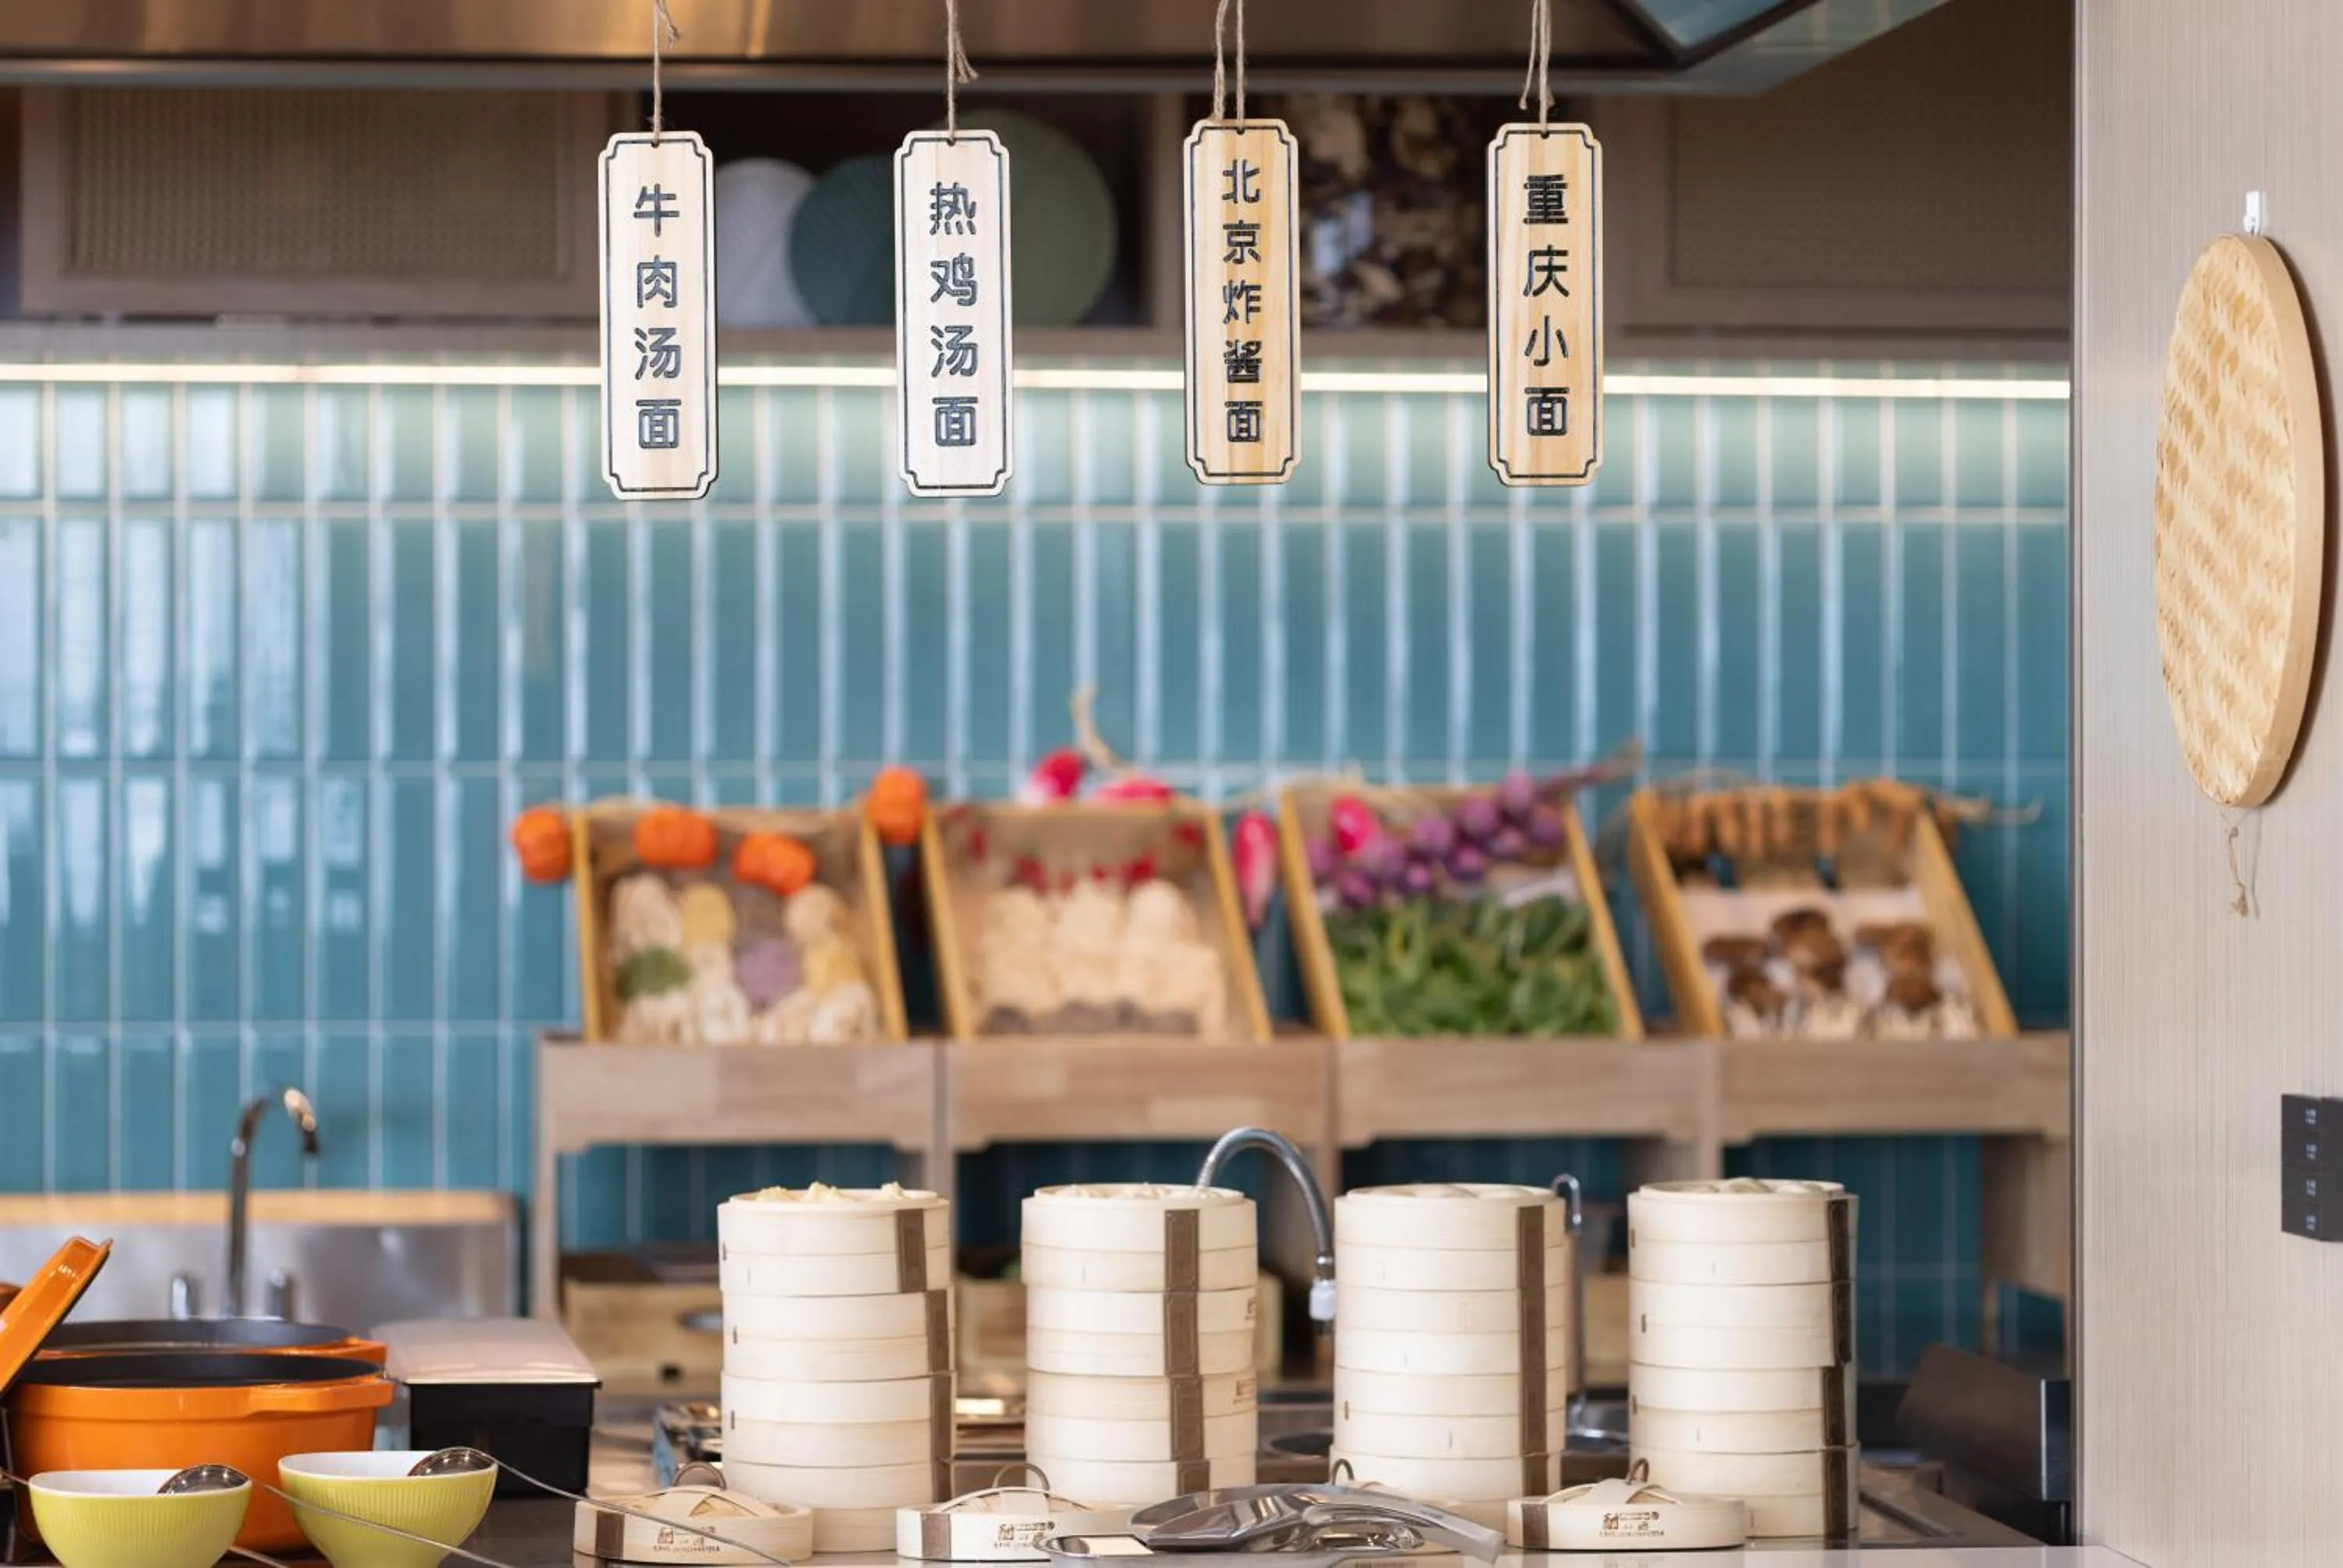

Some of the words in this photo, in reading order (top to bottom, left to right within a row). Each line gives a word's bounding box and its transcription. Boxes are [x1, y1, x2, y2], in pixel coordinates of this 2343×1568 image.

[633, 183, 683, 450] 牛肉汤面
[929, 181, 979, 447] 热鸡汤面
[1221, 159, 1264, 444] 北京炸酱面
[1522, 173, 1571, 437] 重庆小面
